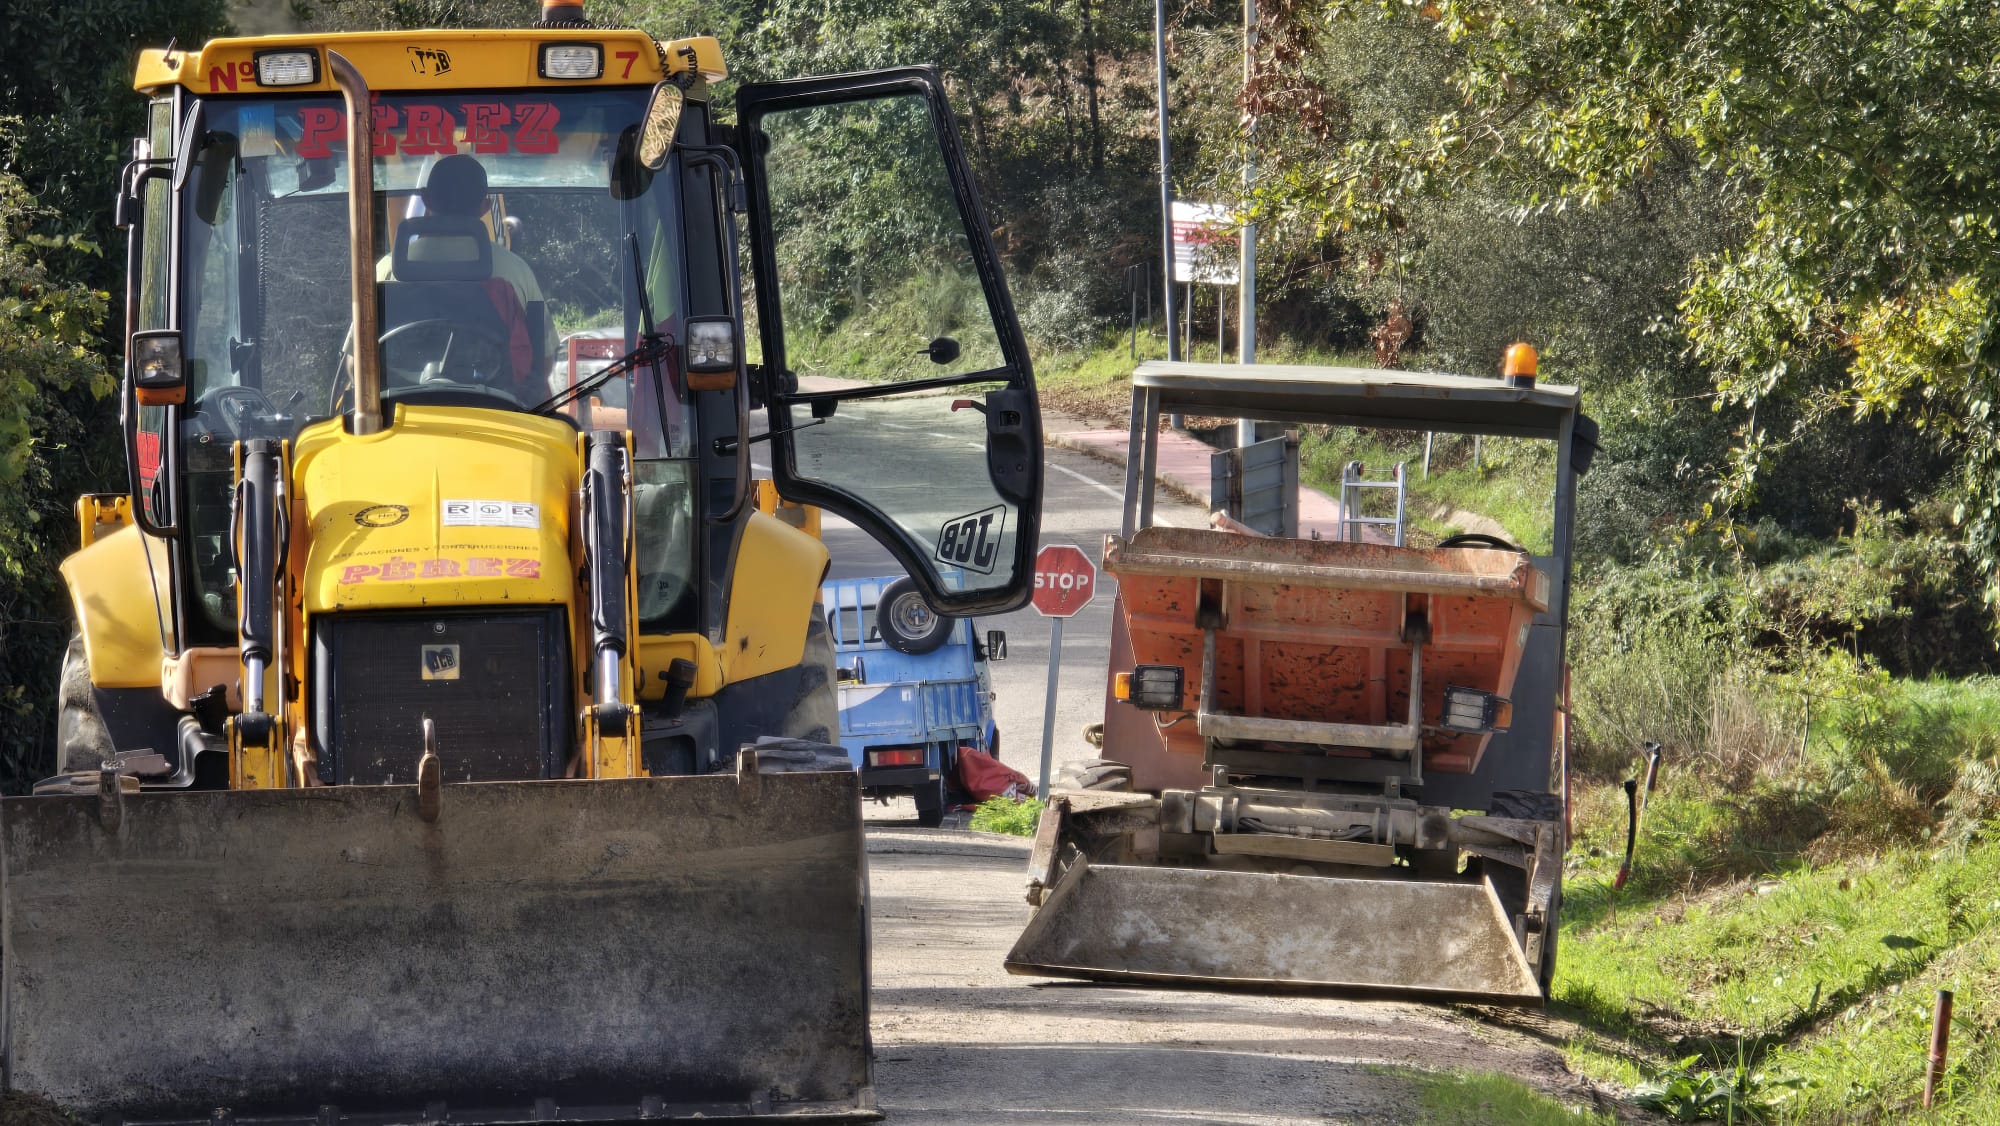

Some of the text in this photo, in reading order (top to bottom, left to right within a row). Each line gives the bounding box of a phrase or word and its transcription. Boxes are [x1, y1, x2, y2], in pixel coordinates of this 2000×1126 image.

[616, 51, 640, 80] 7
[338, 556, 541, 585] PÉREZ
[1034, 572, 1089, 591] STOP
